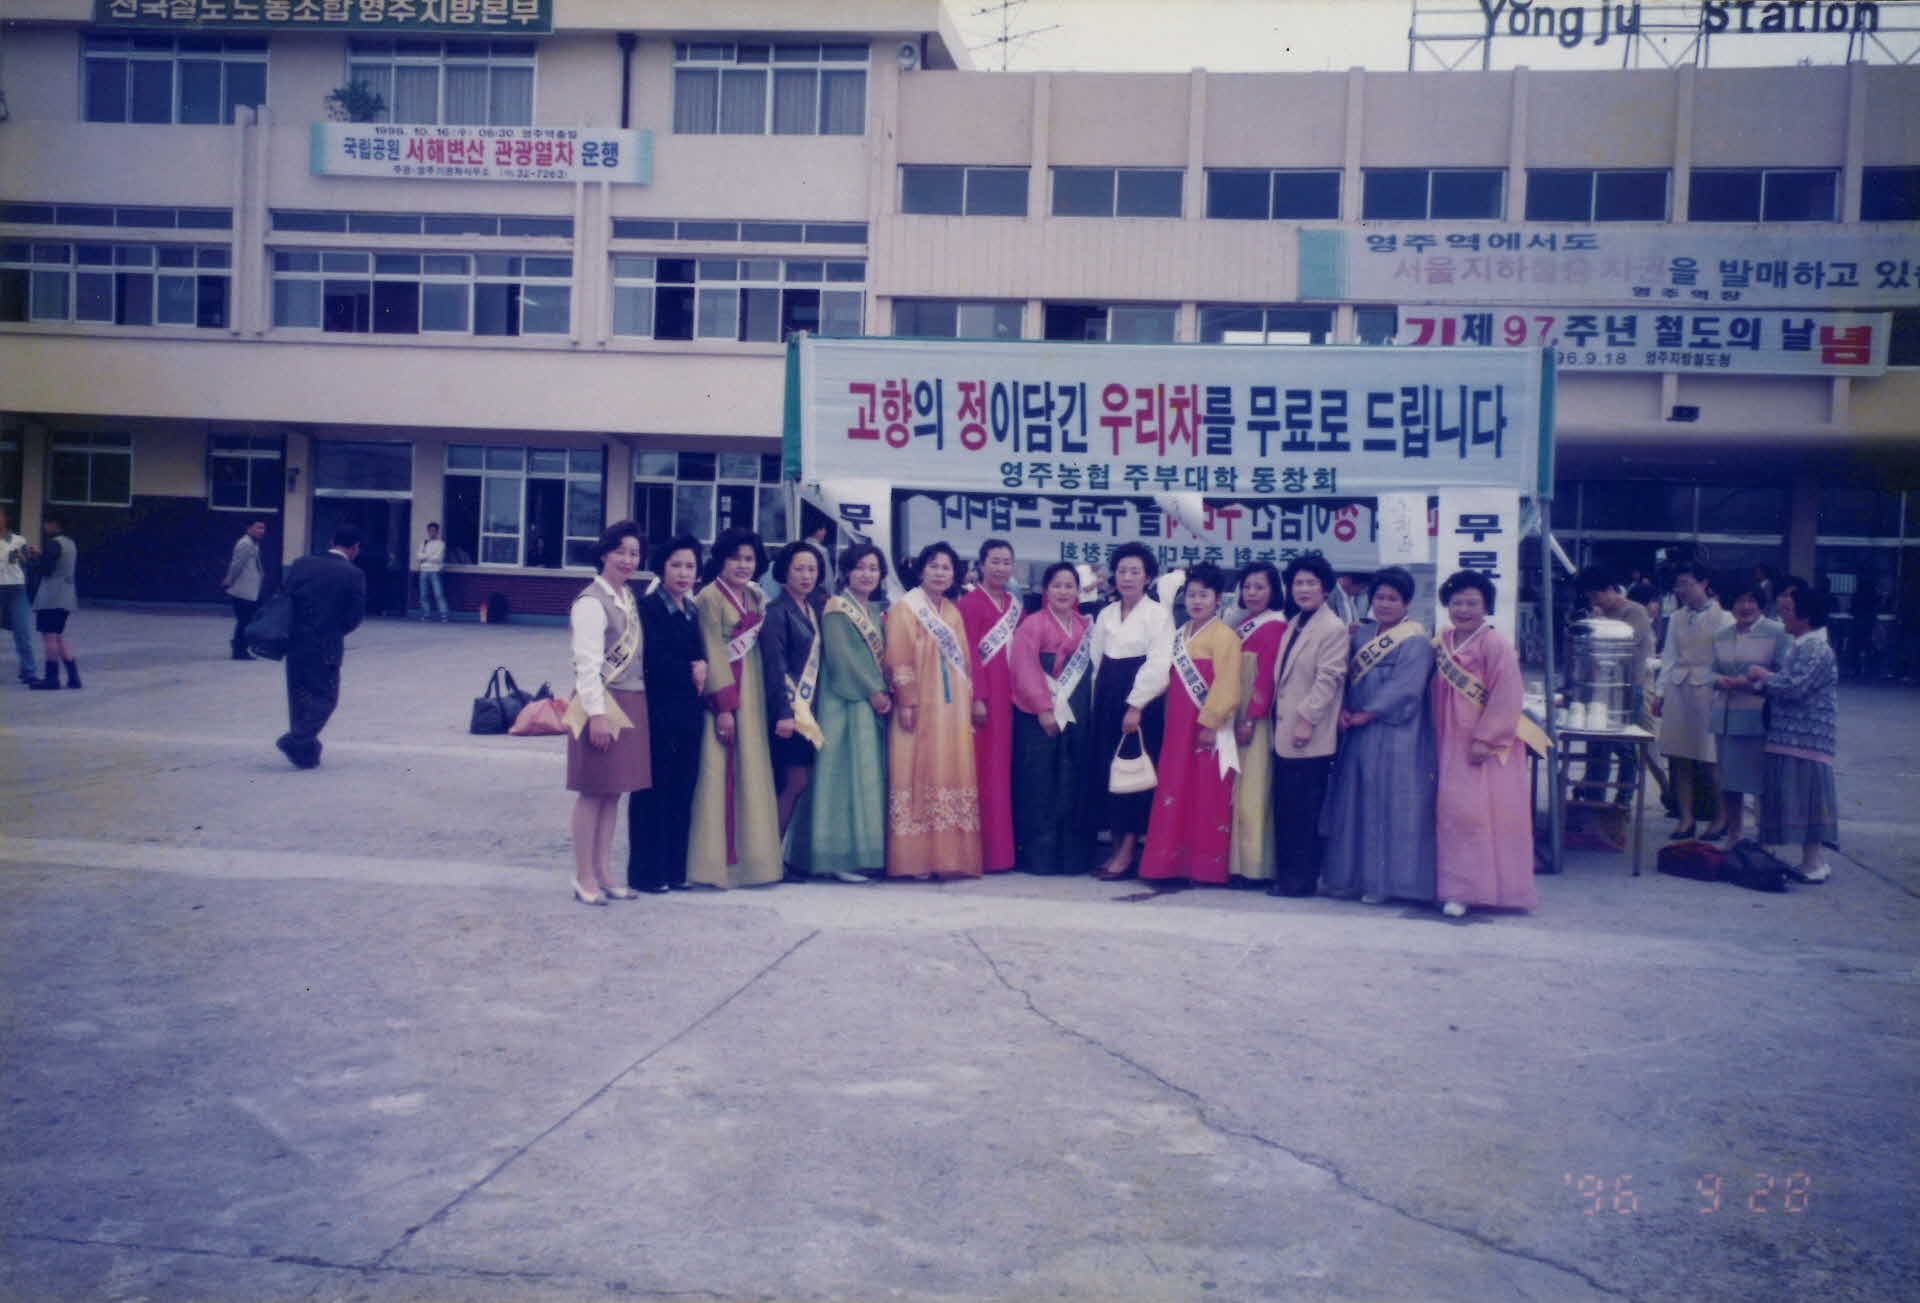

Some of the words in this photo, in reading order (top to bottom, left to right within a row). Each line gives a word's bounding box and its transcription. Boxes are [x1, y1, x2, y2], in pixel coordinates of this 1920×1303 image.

[1703, 0, 1880, 34] Station
[343, 136, 401, 161] 국립공원
[406, 137, 486, 165] 서해변산
[495, 139, 574, 167] 관광열차
[581, 141, 619, 168] 운행
[1365, 232, 1600, 253] 영주역에서도
[1719, 259, 1859, 290] 발매하고
[1875, 260, 1920, 290] 있
[1655, 314, 1762, 350] 철도의
[1782, 317, 1816, 351] 날
[1820, 325, 1873, 365] 념
[847, 378, 944, 451] 고향의
[956, 380, 1089, 453] 정이담긴
[1099, 383, 1236, 457] 우리차를
[1246, 386, 1352, 457] 무료로
[1362, 384, 1508, 459] 드립니다
[999, 461, 1111, 490] 영주농협
[1123, 464, 1239, 493] 주부대학
[1250, 466, 1338, 494] 동창회
